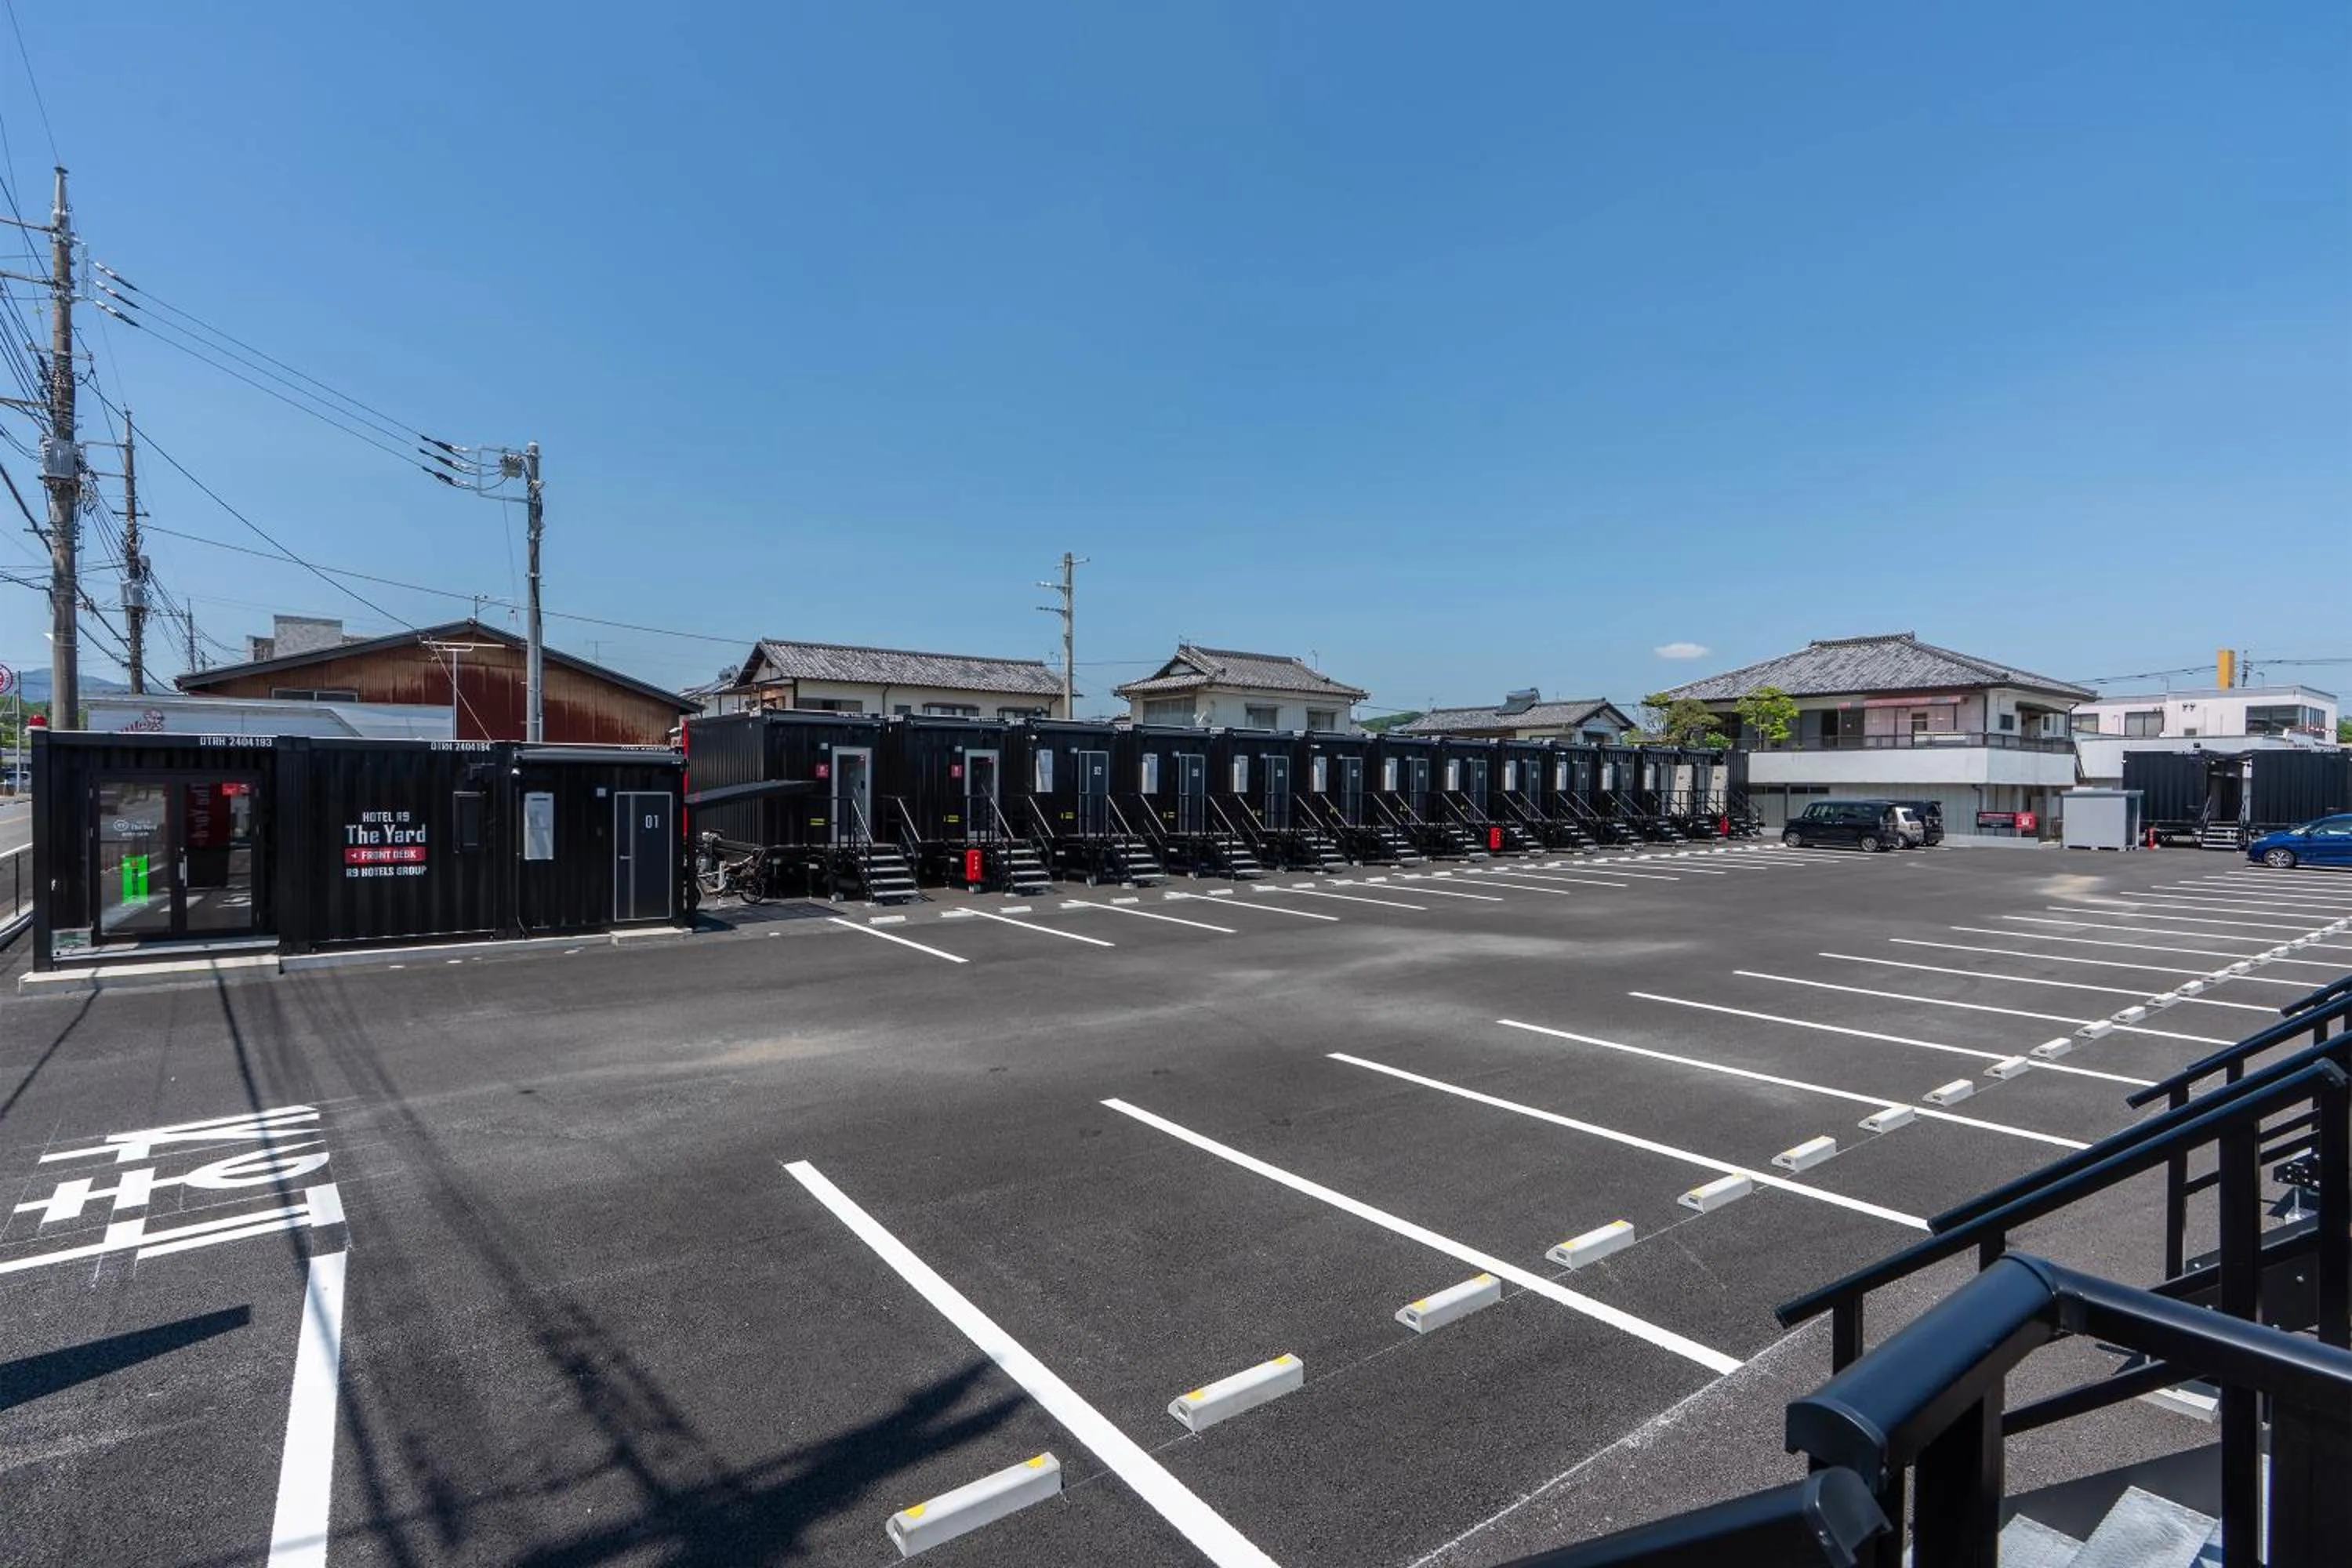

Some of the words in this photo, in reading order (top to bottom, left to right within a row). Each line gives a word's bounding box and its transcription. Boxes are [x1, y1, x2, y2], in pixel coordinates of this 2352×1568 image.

[362, 811, 394, 822] HOTEL
[396, 811, 410, 822] R9
[645, 815, 659, 829] 01
[344, 824, 379, 844] The
[383, 822, 426, 844] Yard
[361, 851, 391, 860] FRONT
[346, 868, 359, 878] R9
[361, 866, 394, 877] HOTELS
[396, 865, 427, 876] GROUP
[0, 1105, 347, 1274] 止まれ
